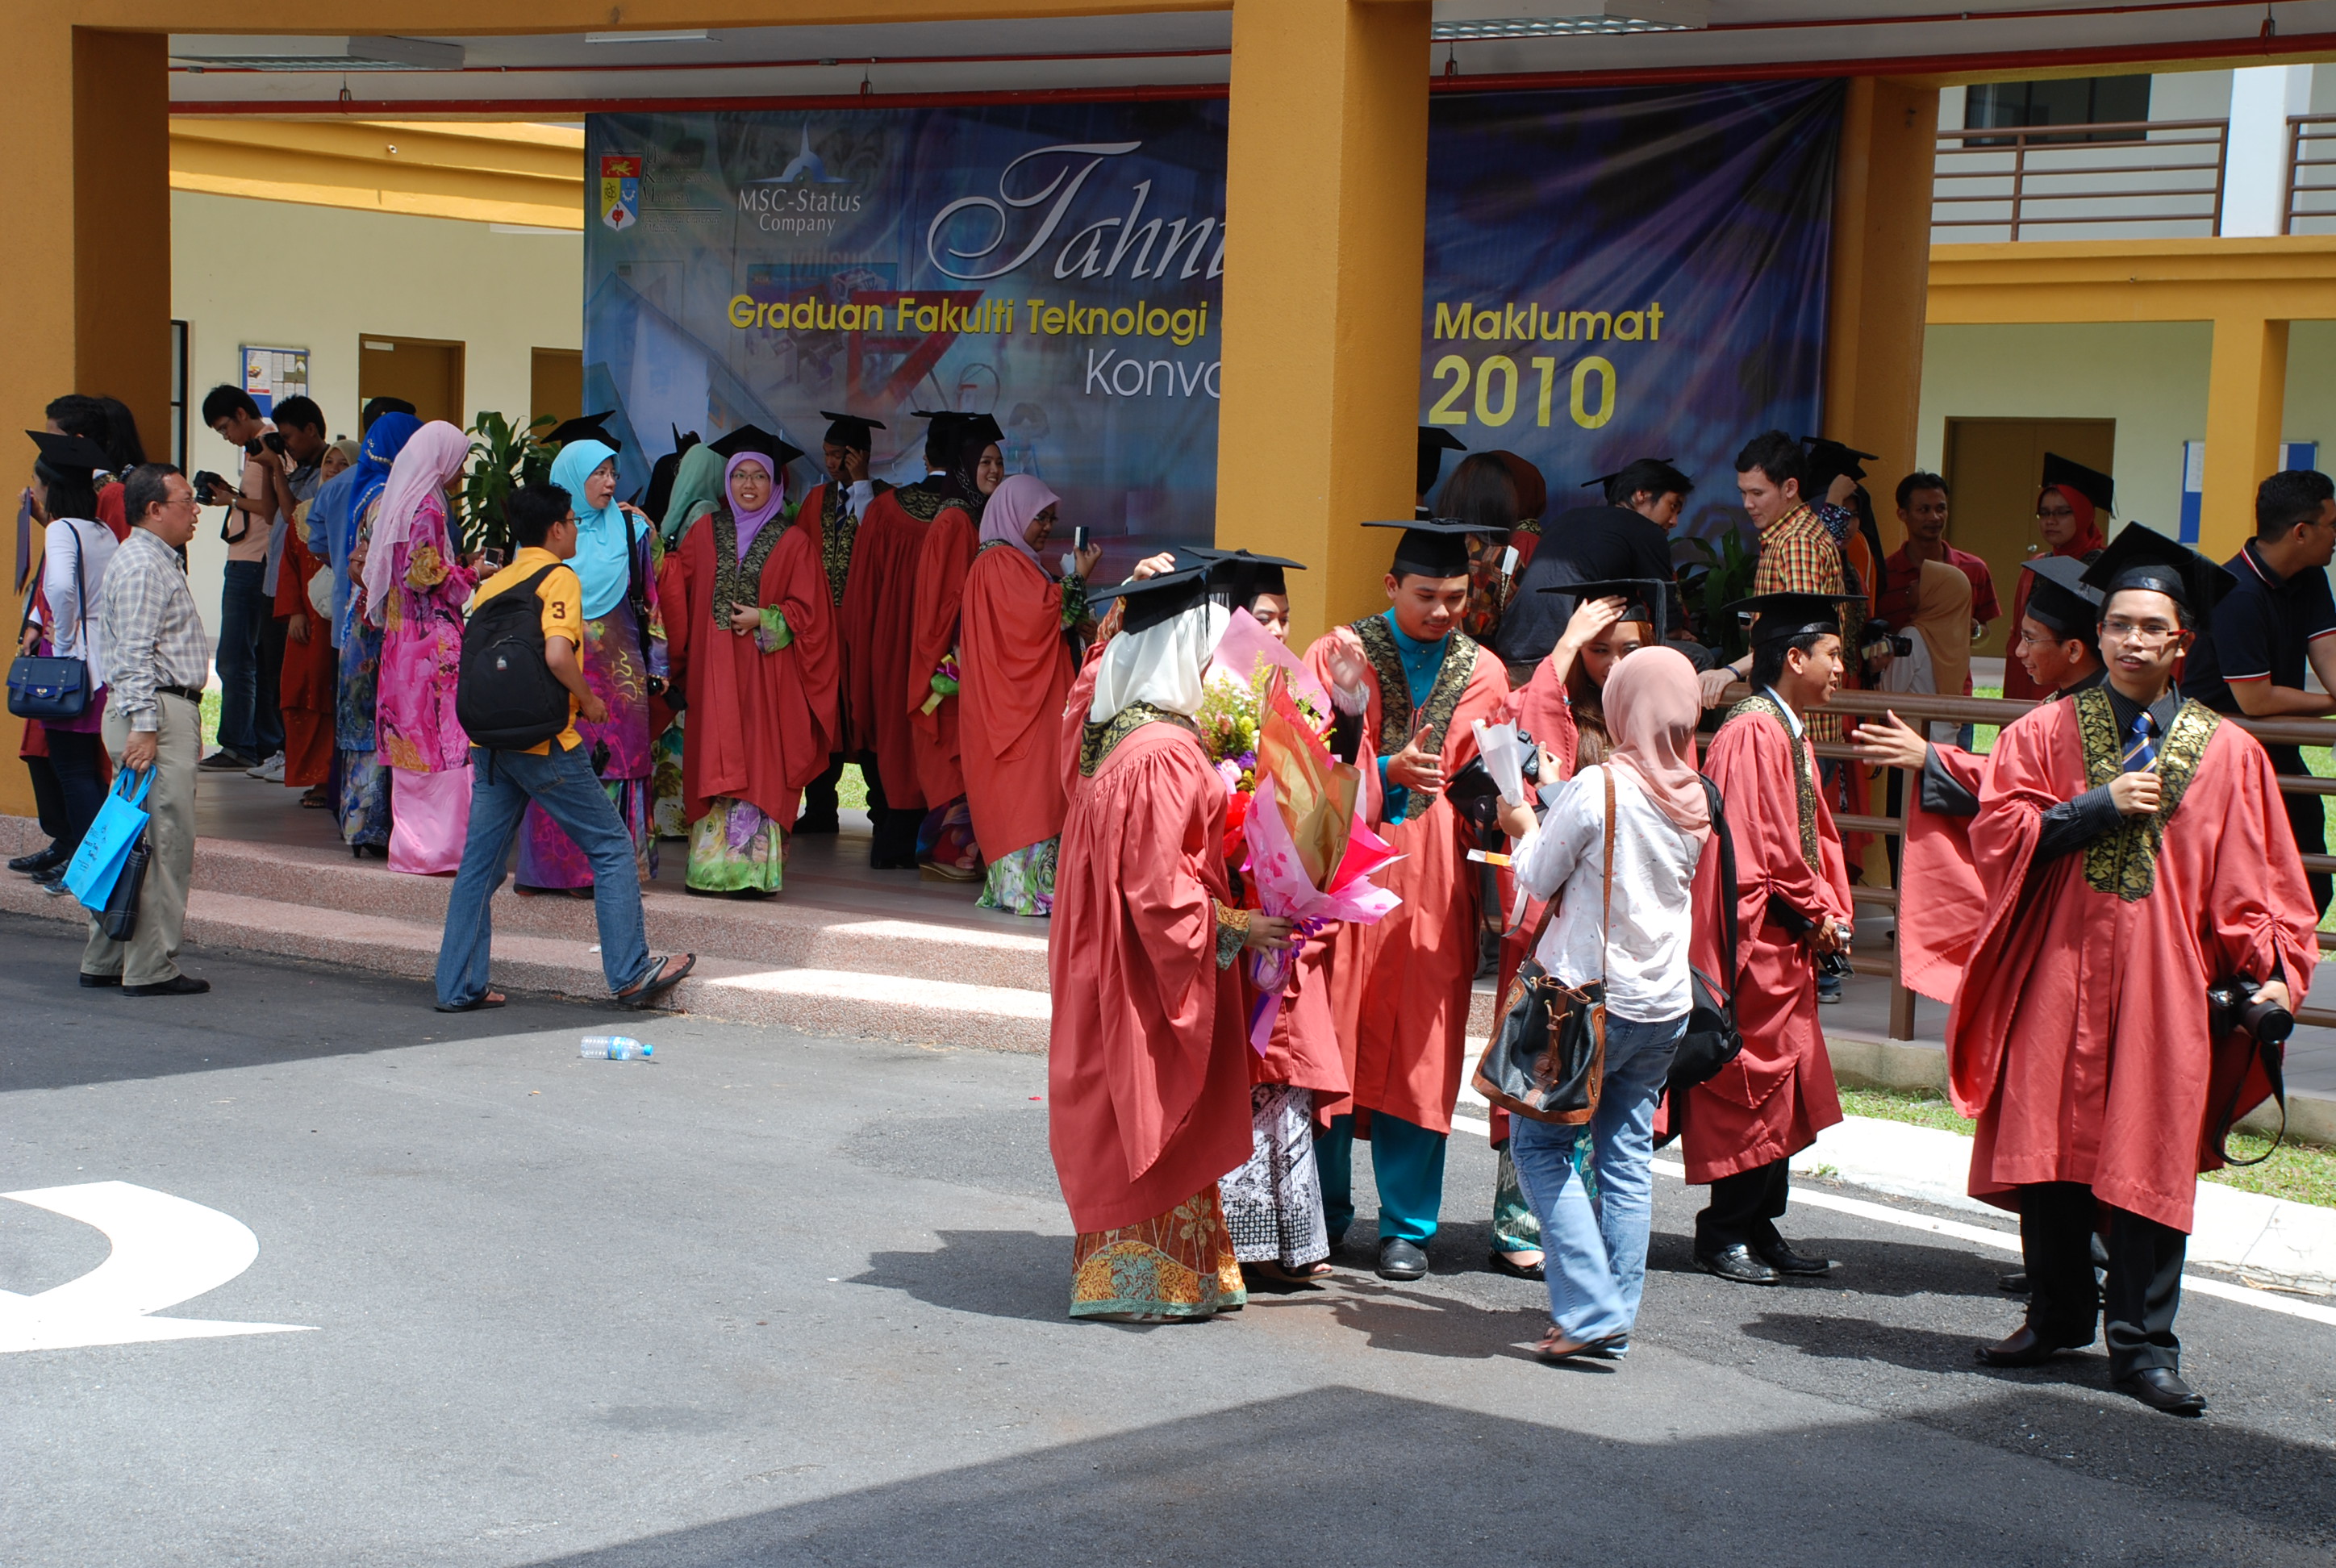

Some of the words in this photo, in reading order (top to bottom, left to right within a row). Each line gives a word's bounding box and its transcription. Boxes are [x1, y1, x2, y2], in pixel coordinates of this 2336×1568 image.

[738, 188, 861, 212] MSC-Status
[759, 213, 836, 237] Company
[728, 294, 884, 332] Graduan
[897, 297, 1014, 334] Fakulti
[1027, 299, 1208, 346] Teknologi
[1433, 302, 1665, 341] Maklumat
[1428, 355, 1616, 429] 2010
[552, 601, 566, 619] 3
